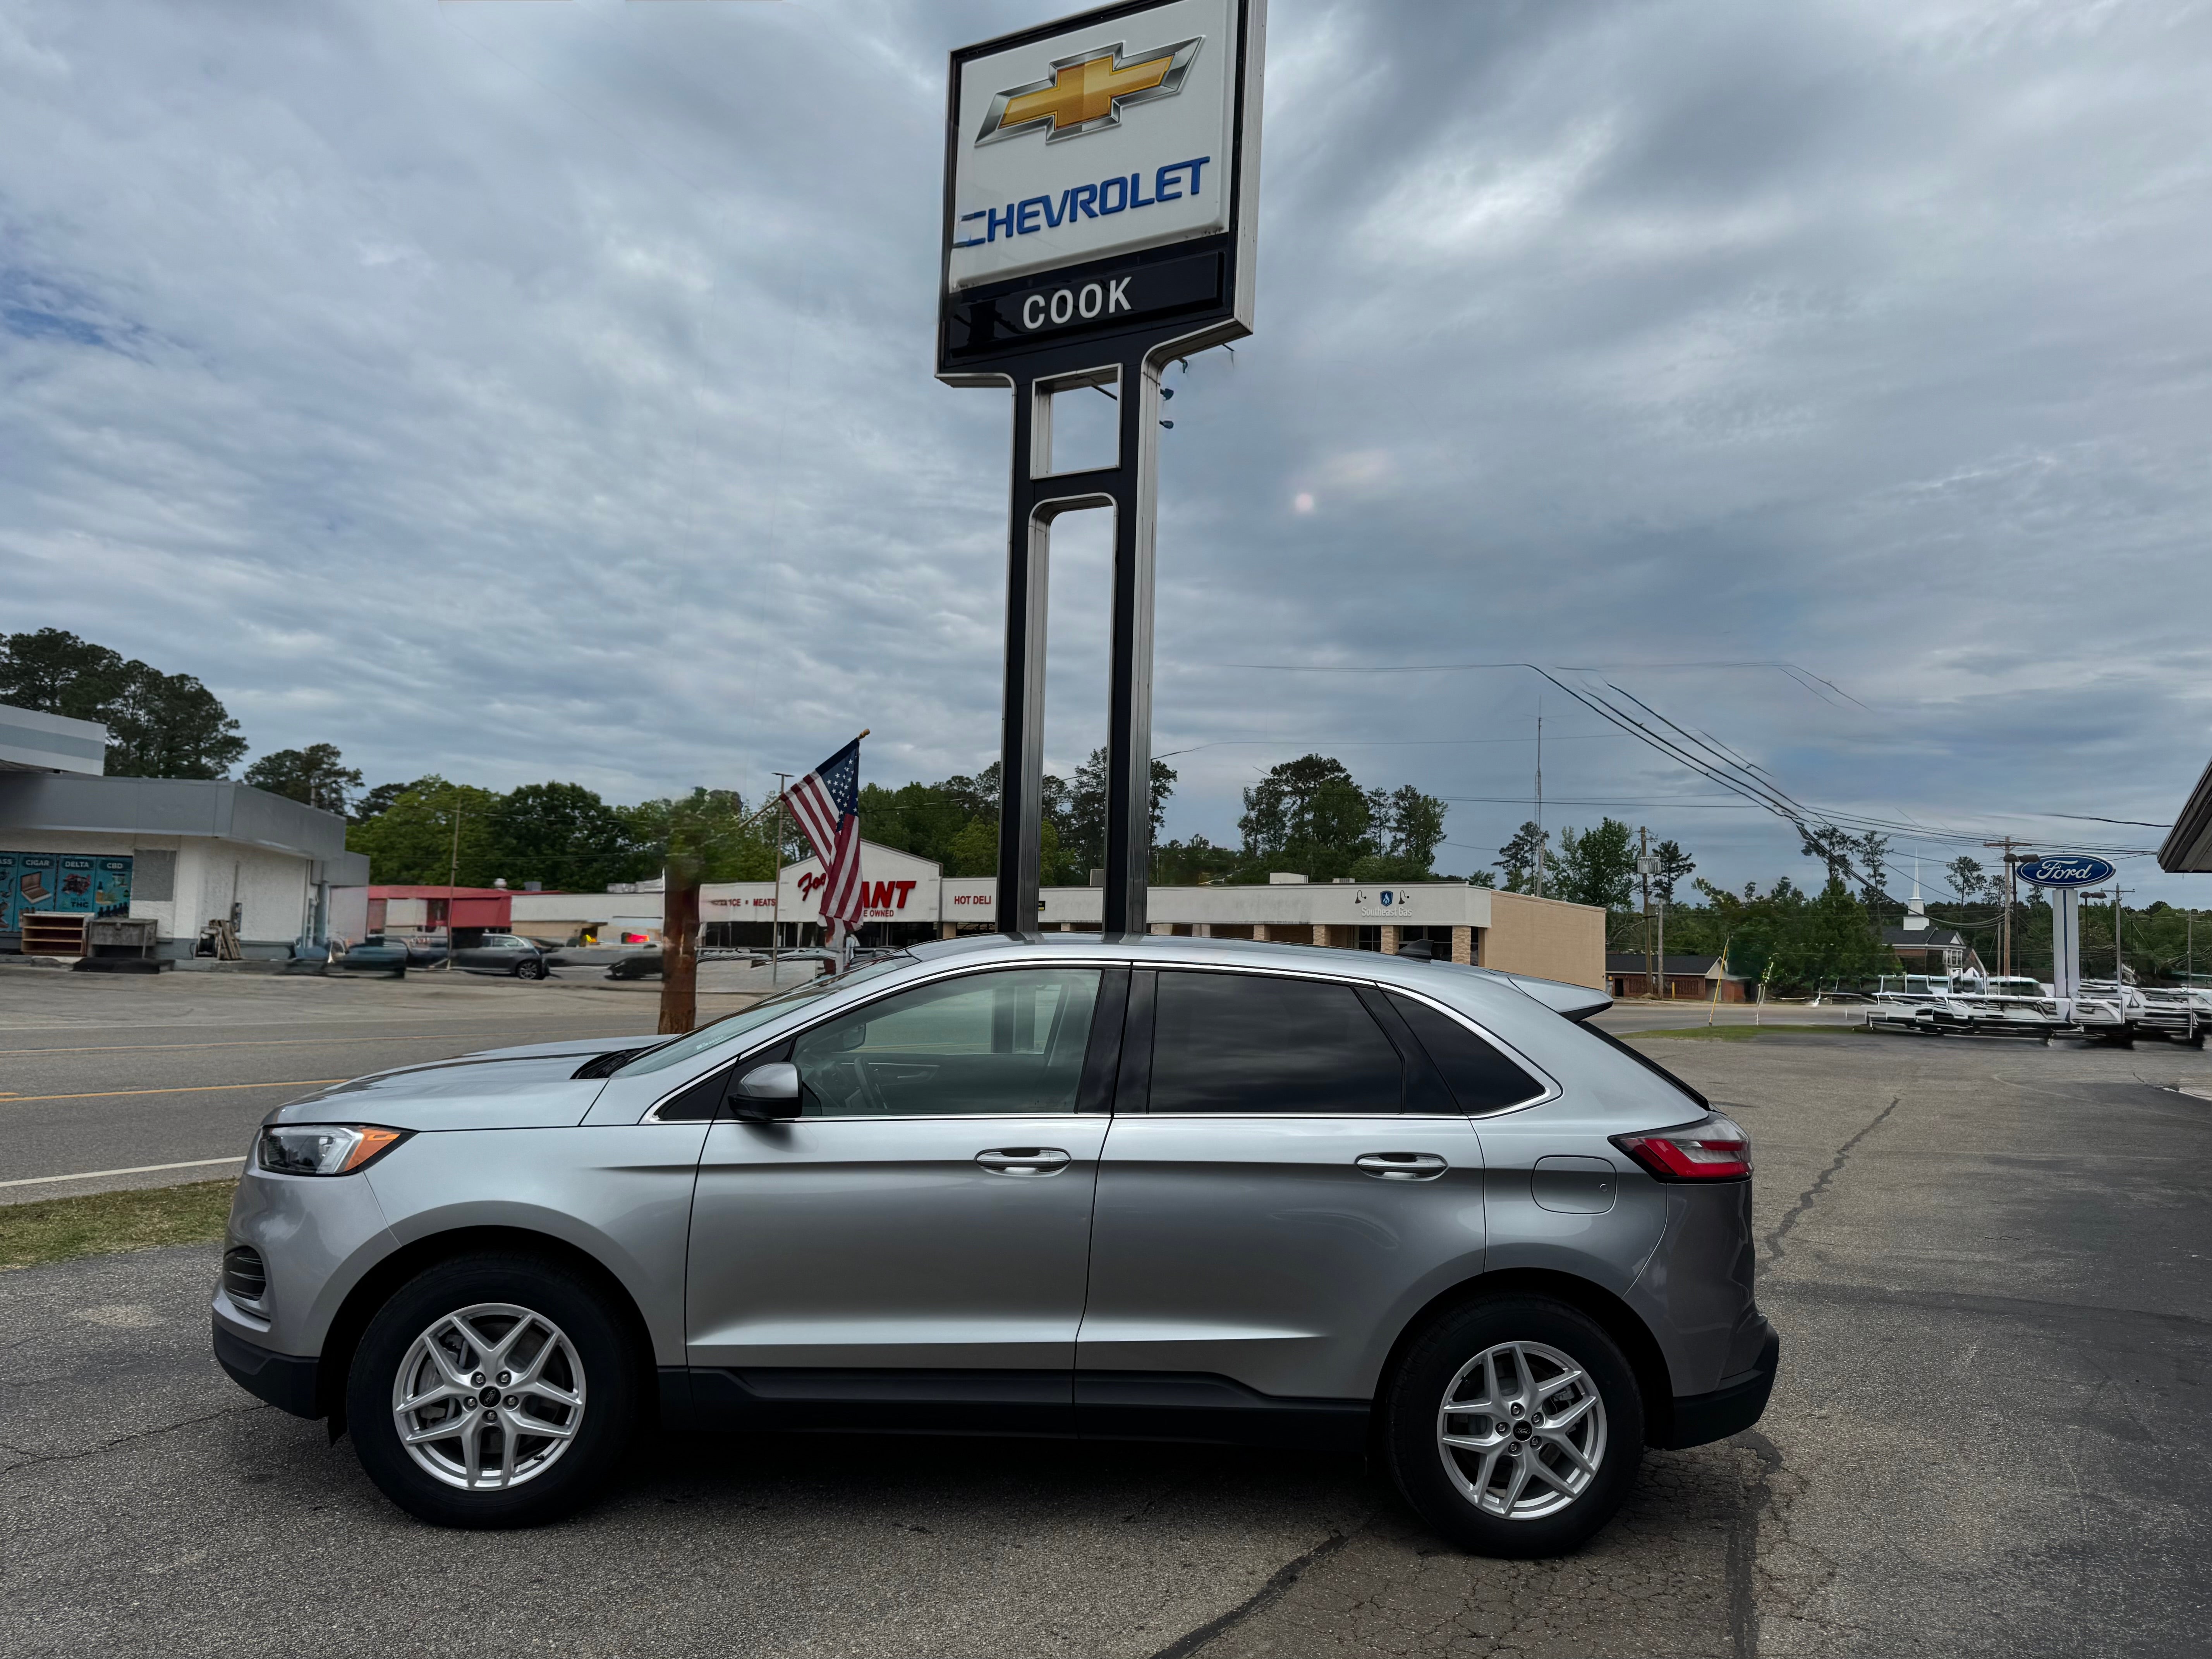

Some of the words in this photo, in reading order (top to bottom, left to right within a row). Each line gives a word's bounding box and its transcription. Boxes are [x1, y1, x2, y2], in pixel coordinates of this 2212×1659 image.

[1023, 276, 1132, 329] COOK
[2036, 860, 2092, 879] Ford
[798, 872, 826, 901] Foo
[955, 896, 971, 904] HOT
[973, 896, 991, 904] DELI
[1362, 907, 1397, 917] Southeast
[1399, 907, 1412, 917] Gas
